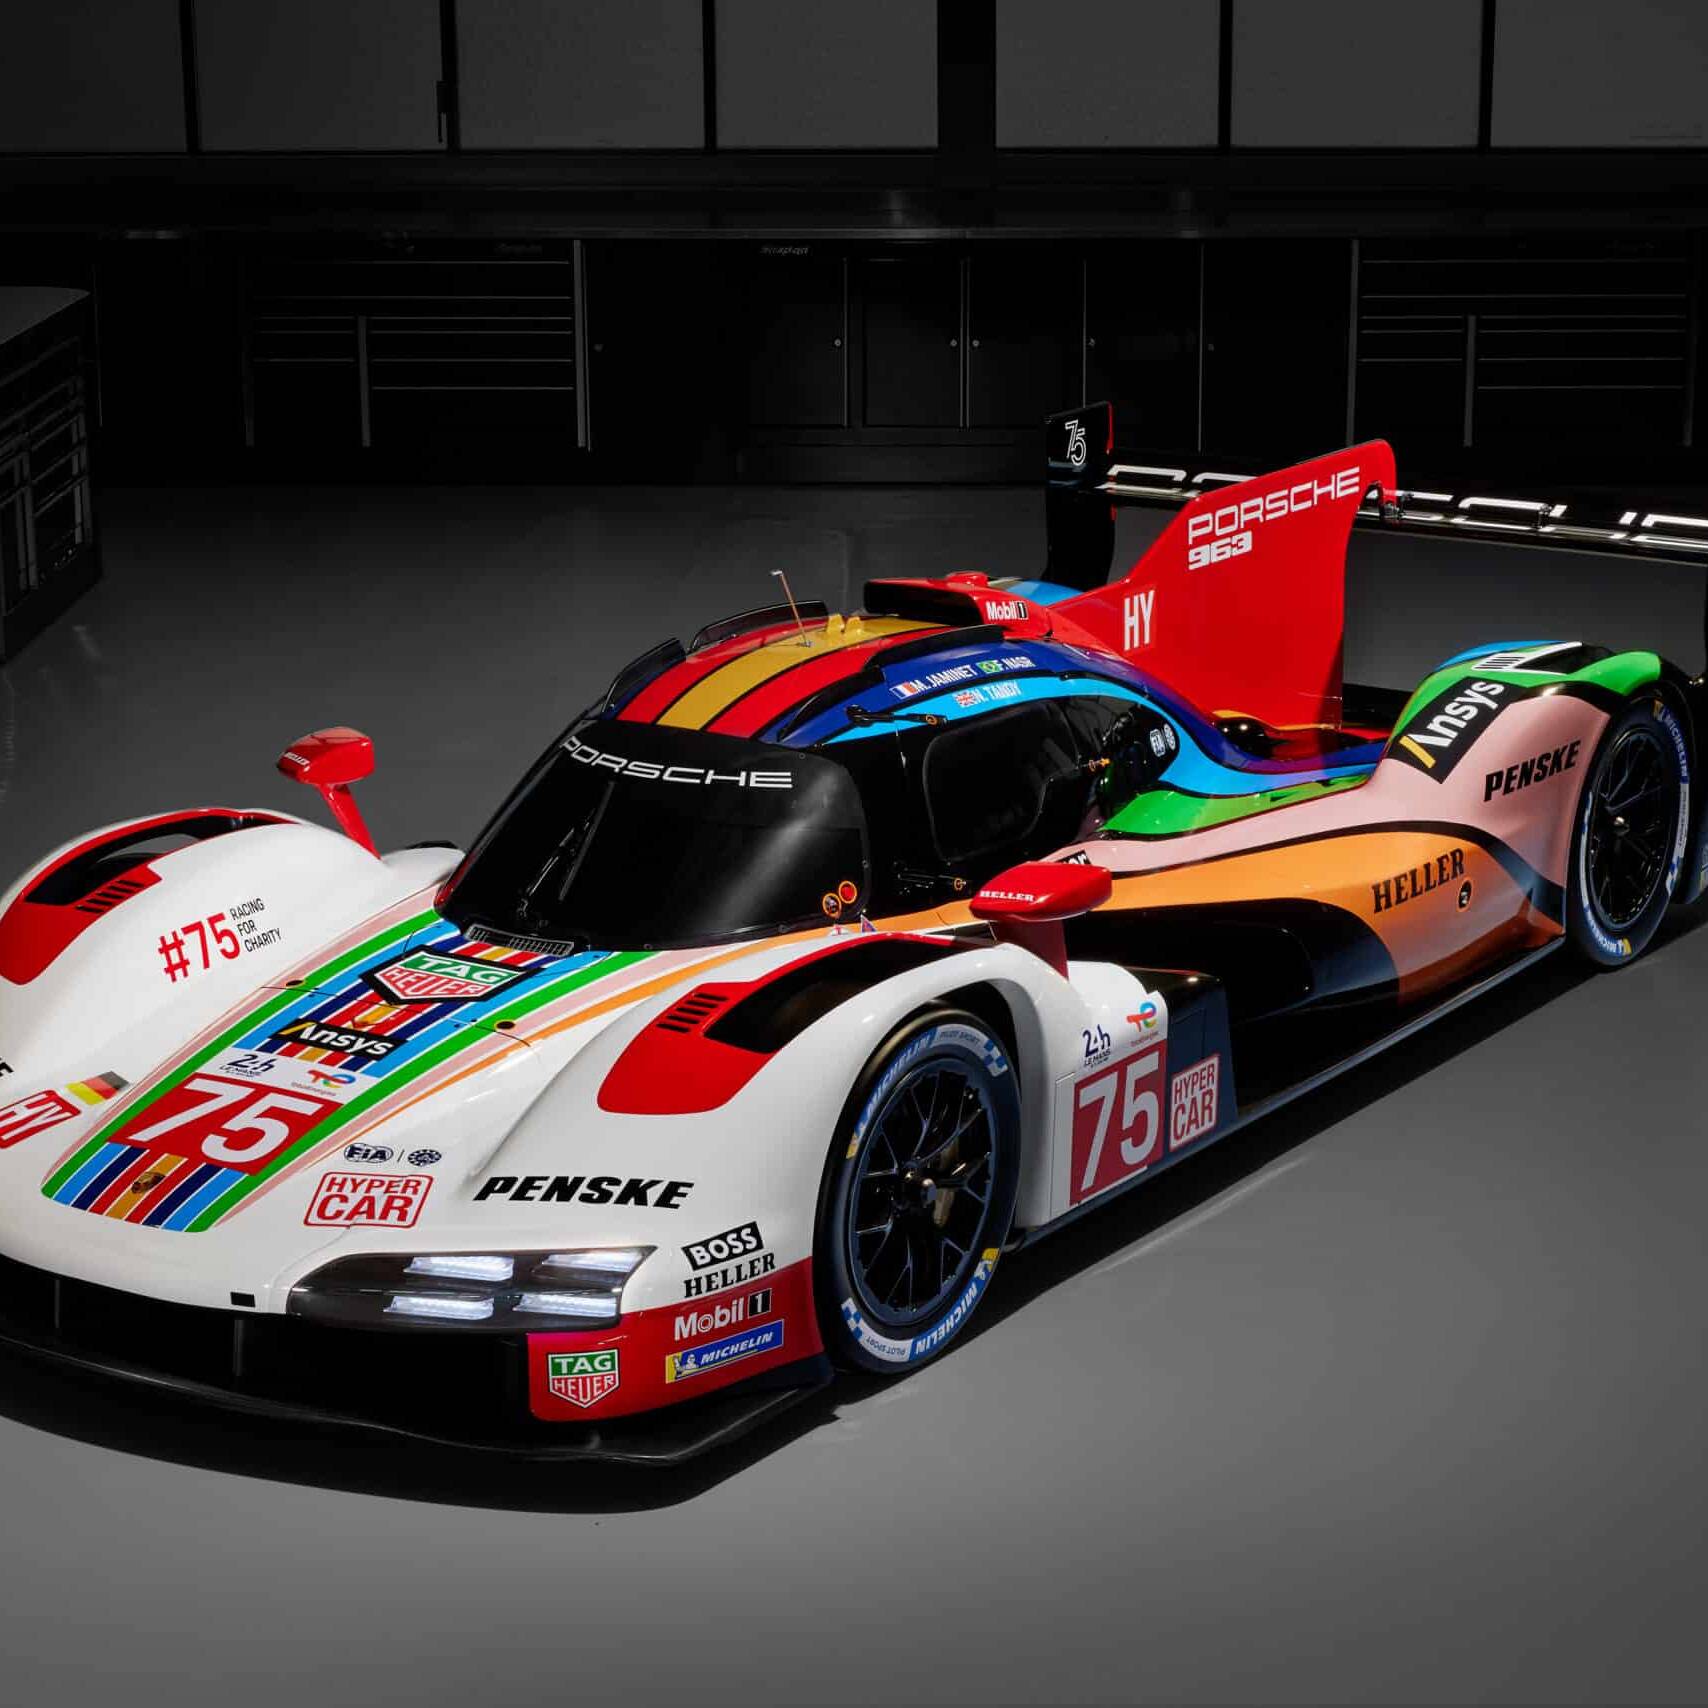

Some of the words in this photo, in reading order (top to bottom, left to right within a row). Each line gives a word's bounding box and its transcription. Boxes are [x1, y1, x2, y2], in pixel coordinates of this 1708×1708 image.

[1065, 420, 1087, 466] 75
[1188, 467, 1360, 545] PORSCHE
[1188, 530, 1252, 570] 963
[986, 601, 1016, 620] Mobil
[1124, 590, 1155, 650] HY
[926, 664, 978, 689] JAMINET
[1399, 681, 1505, 768] Ansys
[560, 735, 793, 788] PORSCHE
[1483, 740, 1581, 802] PENSKE
[980, 891, 1034, 902] HELLER
[1372, 848, 1465, 914] HELLER
[230, 898, 264, 920] RACING
[237, 919, 257, 936] FOR
[158, 912, 240, 982] #75
[244, 928, 281, 952] CHARITY
[382, 967, 489, 998] HEUER
[417, 957, 512, 984] TAG
[280, 1021, 395, 1057] Ansys
[1174, 1063, 1216, 1104] HYPER
[128, 1078, 325, 1164] 75
[1079, 1051, 1160, 1192] 75
[1173, 1088, 1214, 1140] CAR
[326, 1177, 422, 1195] HYPER
[472, 1176, 694, 1209] PENSKE
[317, 1194, 413, 1222] CAR
[689, 1228, 757, 1266] BOSS
[684, 1252, 776, 1298] HELLER
[674, 1297, 745, 1341] Mobil
[915, 1282, 978, 1355] MICHELIN
[554, 1355, 612, 1374] TAG
[701, 1331, 774, 1365] MICHELIN
[554, 1375, 614, 1403] HEUER
